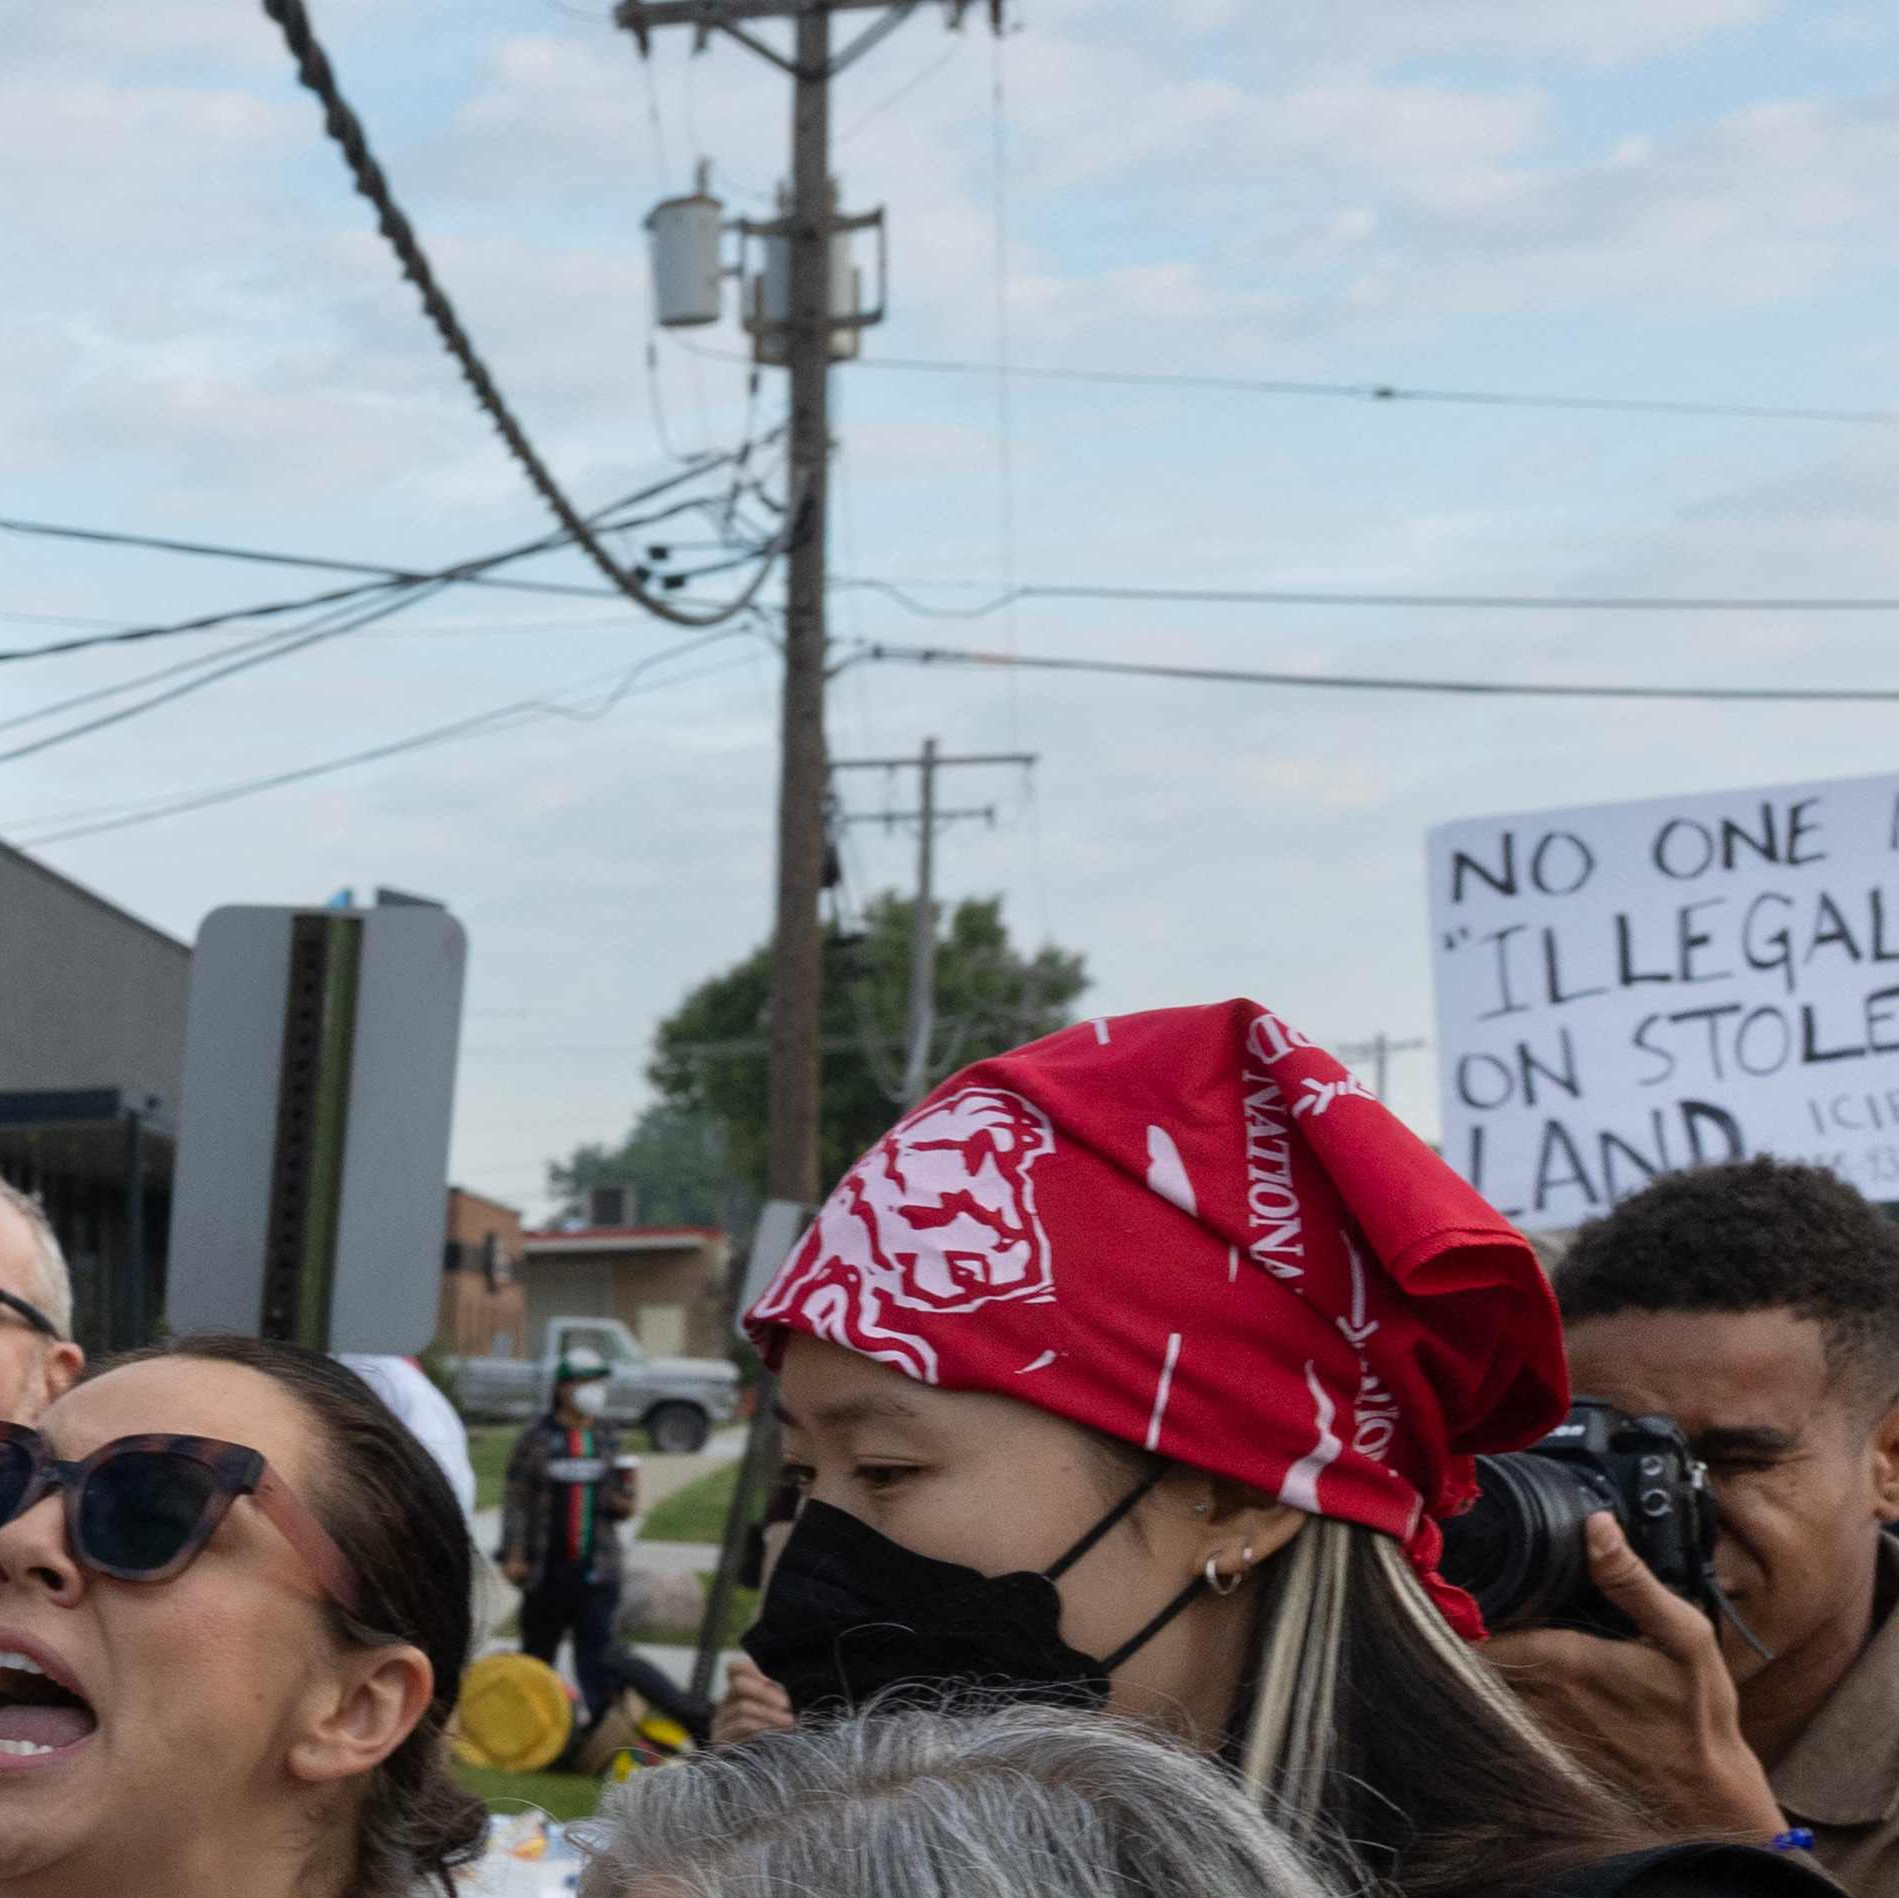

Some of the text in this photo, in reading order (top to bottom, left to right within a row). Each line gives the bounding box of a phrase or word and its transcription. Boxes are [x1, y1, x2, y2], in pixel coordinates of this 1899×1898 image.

[1450, 830, 1596, 903] NO
[1652, 797, 1828, 881] ONE
[1455, 1025, 1583, 1111] ON
[1242, 1069, 1307, 1296] NATIONA
[1467, 1098, 1746, 1220] LAND
